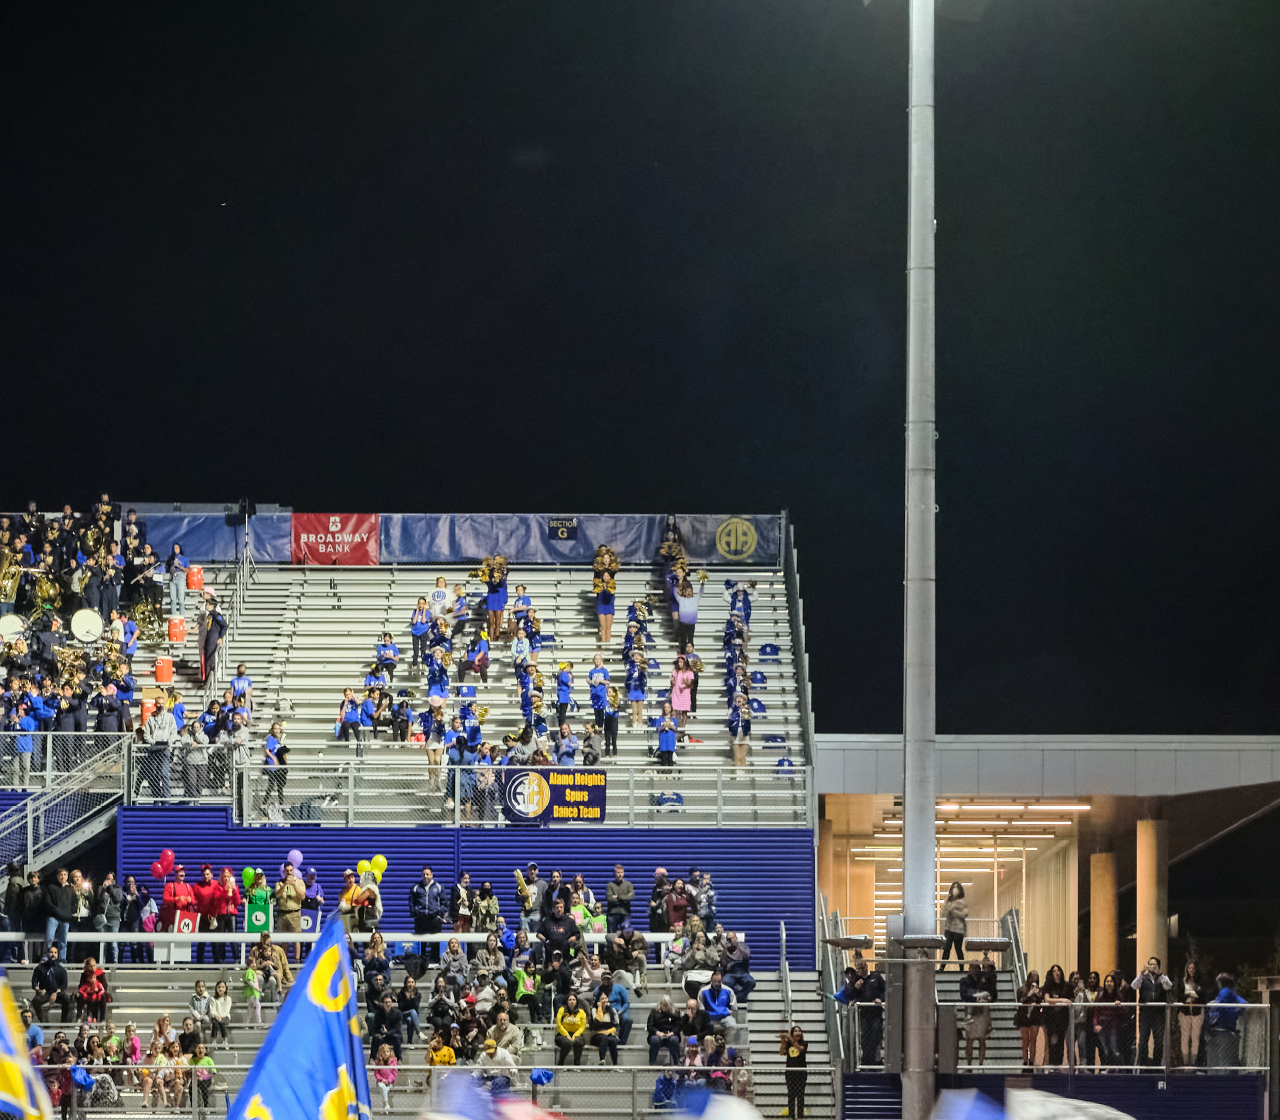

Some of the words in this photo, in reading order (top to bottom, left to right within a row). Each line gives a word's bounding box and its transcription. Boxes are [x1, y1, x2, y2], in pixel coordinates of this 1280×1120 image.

[550, 520, 577, 528] SECTION
[300, 533, 369, 543] BROADWAY
[558, 528, 568, 538] G
[319, 544, 351, 553] BANK
[549, 772, 574, 785] Alamo
[574, 773, 606, 787] Heights
[565, 788, 589, 802] Spurs
[553, 805, 578, 818] Dance
[579, 805, 601, 818] Team
[182, 921, 190, 930] M
